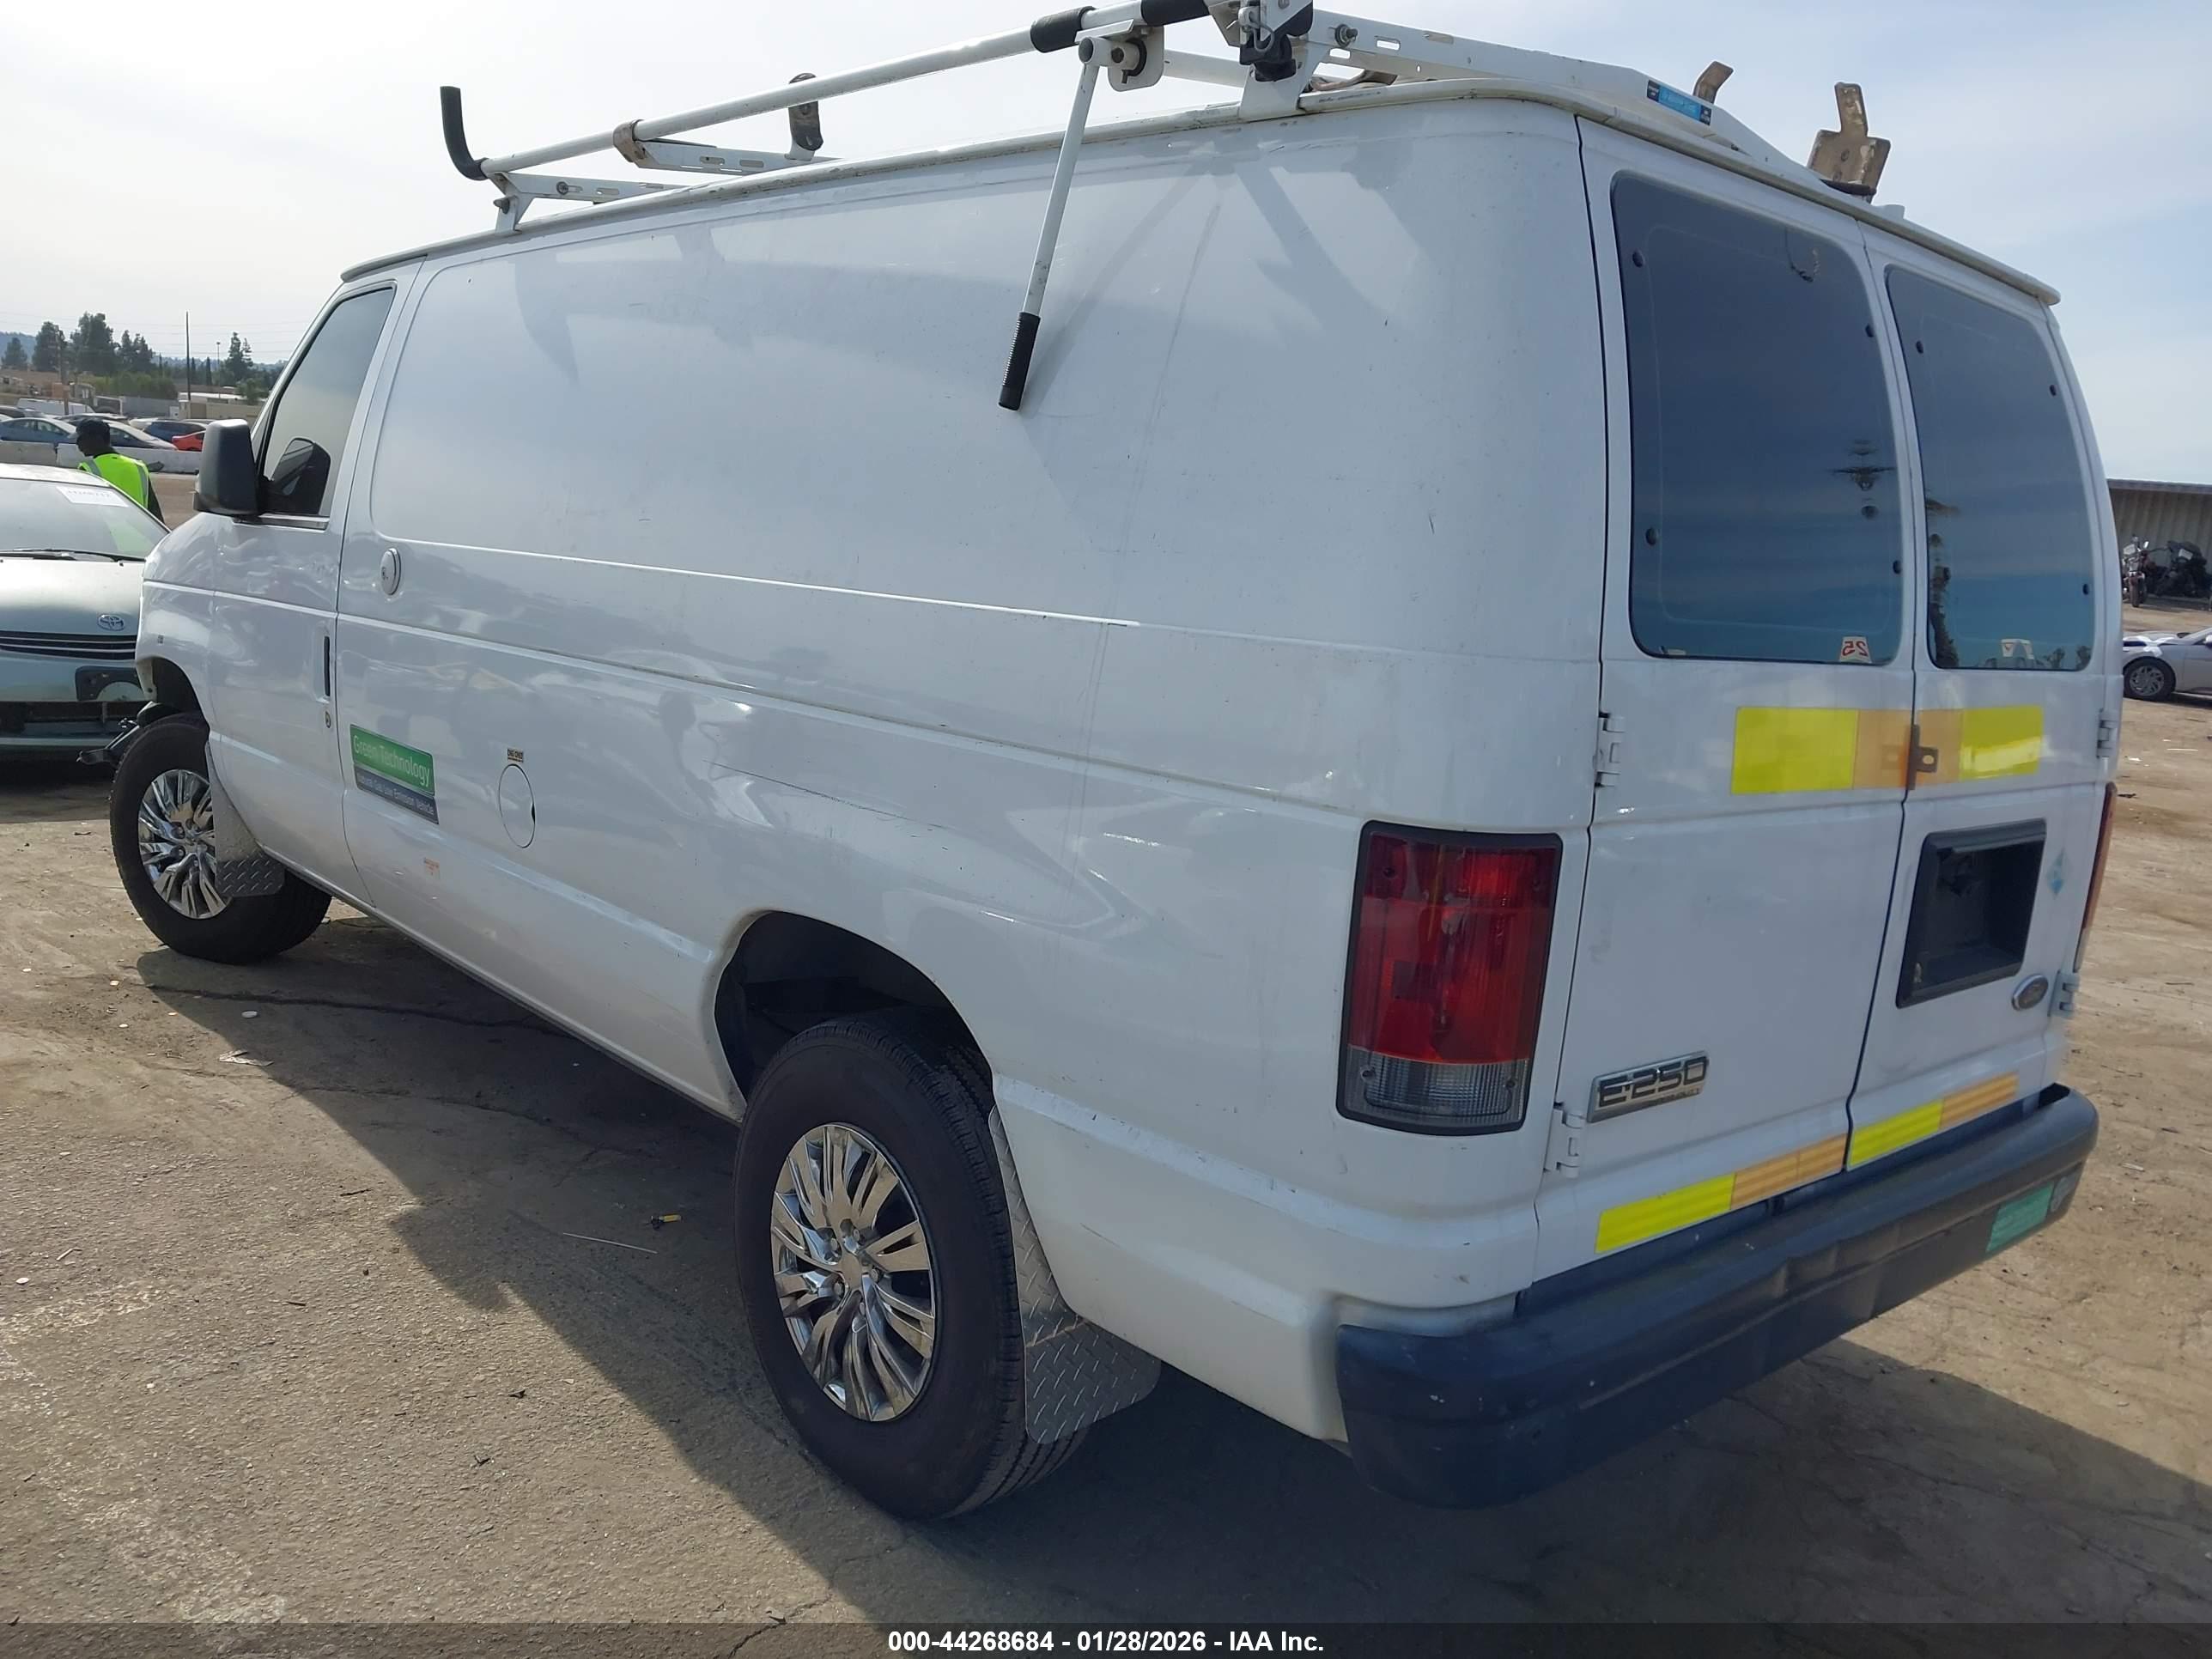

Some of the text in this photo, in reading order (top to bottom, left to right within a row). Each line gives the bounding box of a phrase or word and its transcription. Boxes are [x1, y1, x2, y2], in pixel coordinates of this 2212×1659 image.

[353, 734, 430, 787] Green Technology
[1598, 1055, 1708, 1108] E-250
